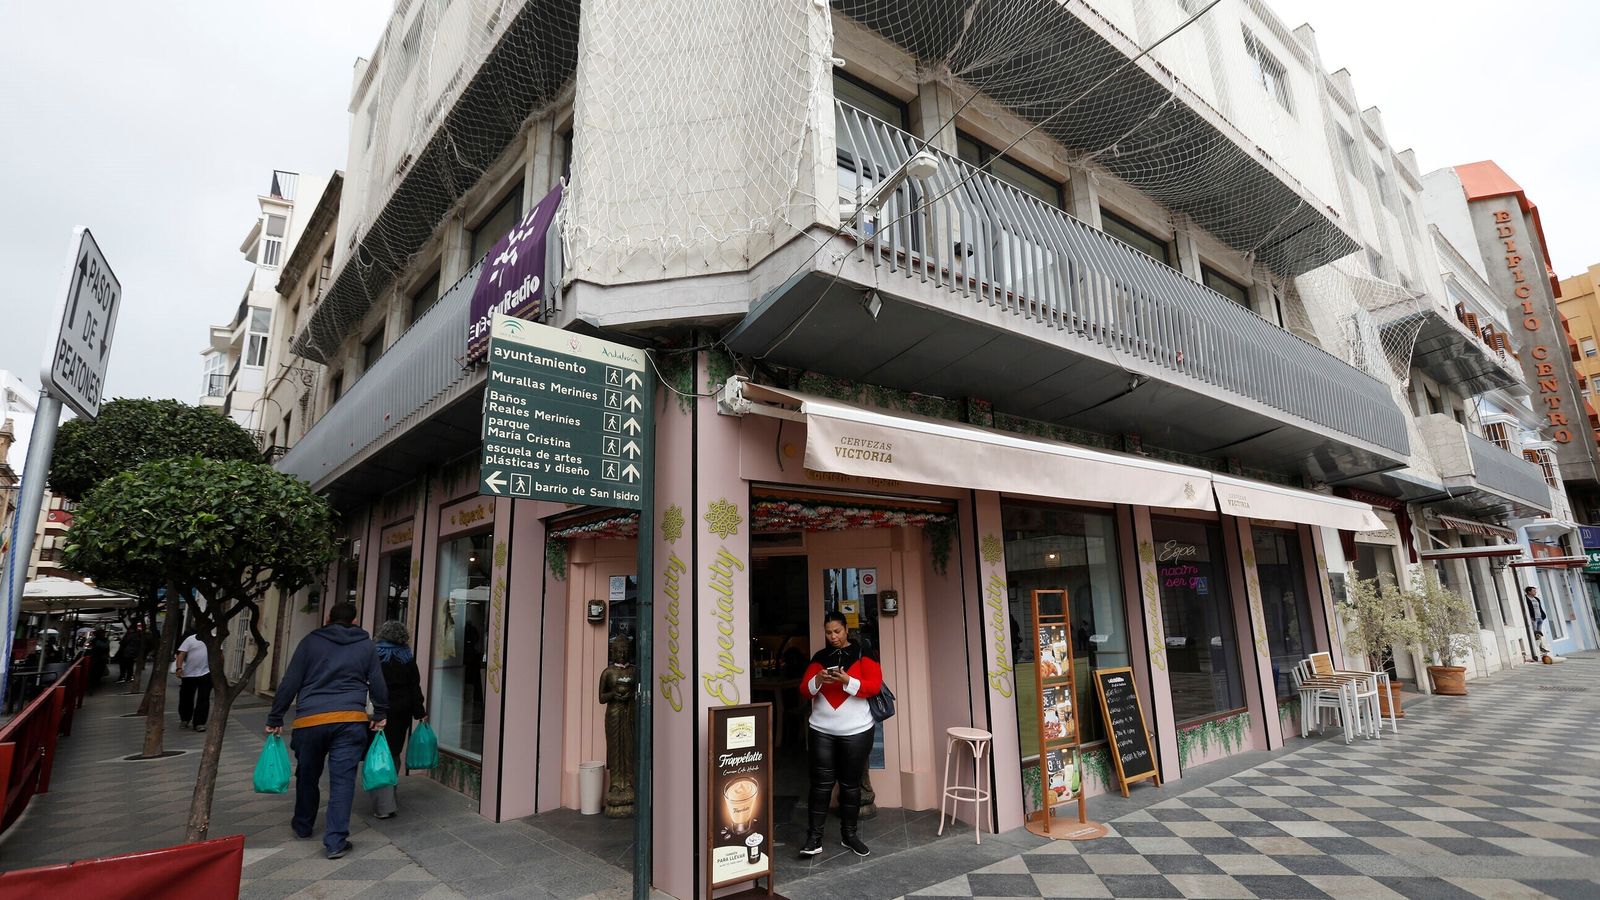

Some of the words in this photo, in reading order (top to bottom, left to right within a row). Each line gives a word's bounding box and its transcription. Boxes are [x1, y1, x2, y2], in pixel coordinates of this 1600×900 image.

[86, 258, 110, 312] PASO
[83, 310, 98, 350] DE
[1493, 211, 1541, 331] EDIFICIO
[1532, 345, 1572, 444] CENTRO
[494, 346, 587, 374] ayuntamiento
[56, 338, 100, 408] PEATONES
[491, 370, 546, 390] Murallas
[550, 382, 598, 401] Meriníes
[490, 390, 527, 406] Baños
[488, 416, 530, 430] parque
[489, 401, 529, 418] Reales
[534, 409, 581, 426] Meriníes
[487, 426, 521, 441] María
[526, 433, 571, 448] Cristina
[840, 436, 892, 451] CERVEZAS
[485, 454, 540, 470] plásticas
[544, 463, 551, 473] y
[555, 463, 590, 476] diseño
[486, 444, 531, 457] escuela
[536, 449, 550, 460] de
[554, 453, 582, 464] artes
[834, 446, 892, 464] VICTORIA
[535, 481, 568, 495] barrio
[572, 486, 586, 496] de
[590, 488, 609, 499] San
[613, 490, 640, 502] Isidro
